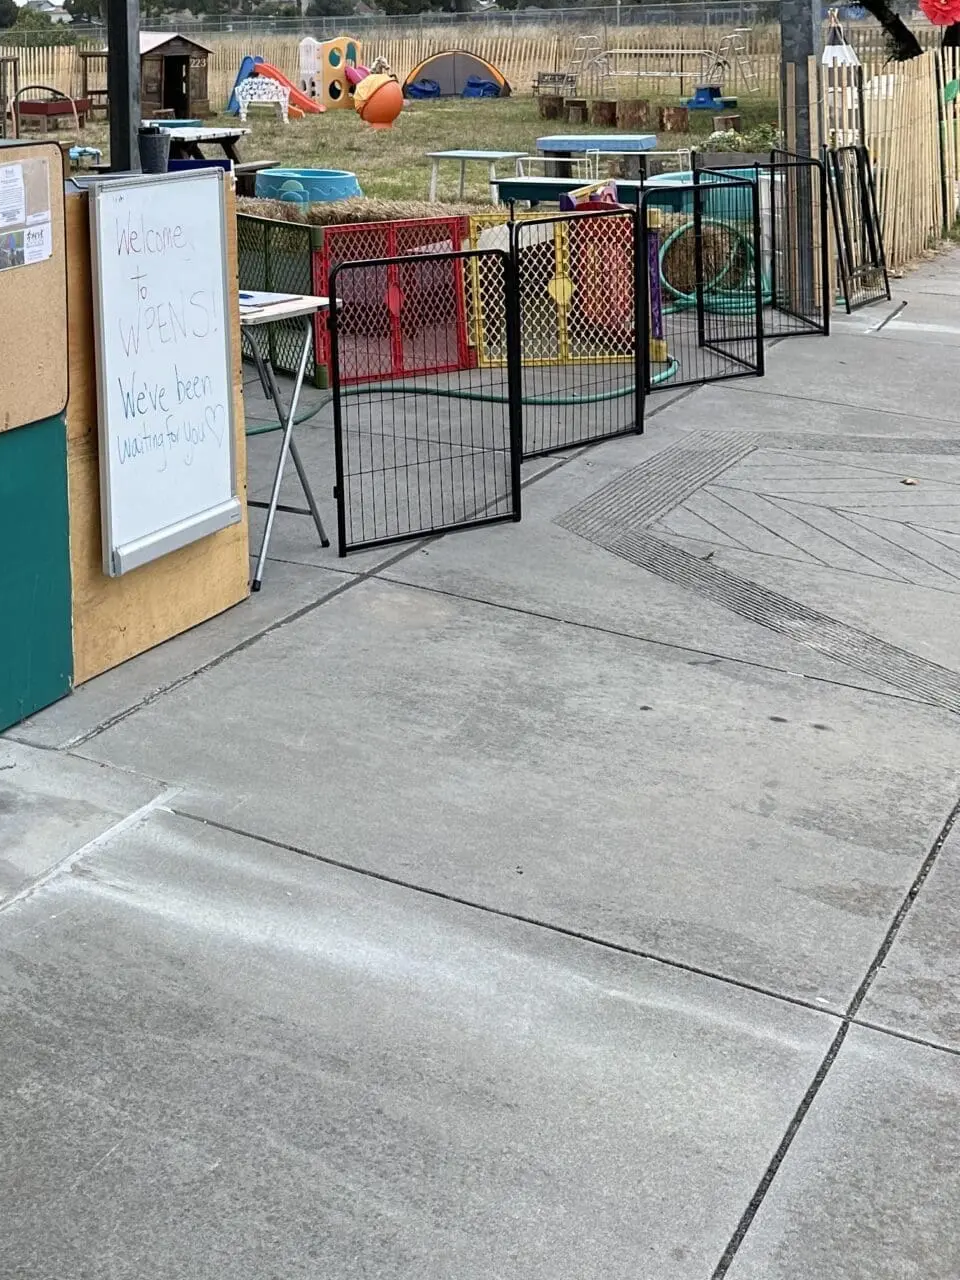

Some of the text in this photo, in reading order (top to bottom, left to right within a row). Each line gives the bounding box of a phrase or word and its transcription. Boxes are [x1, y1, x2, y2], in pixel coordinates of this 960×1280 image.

[190, 58, 207, 68] 223
[115, 210, 187, 256] Welcome
[118, 290, 218, 357] WPENS!
[118, 364, 212, 419] We've been
[166, 414, 179, 450] for
[183, 420, 206, 466] you
